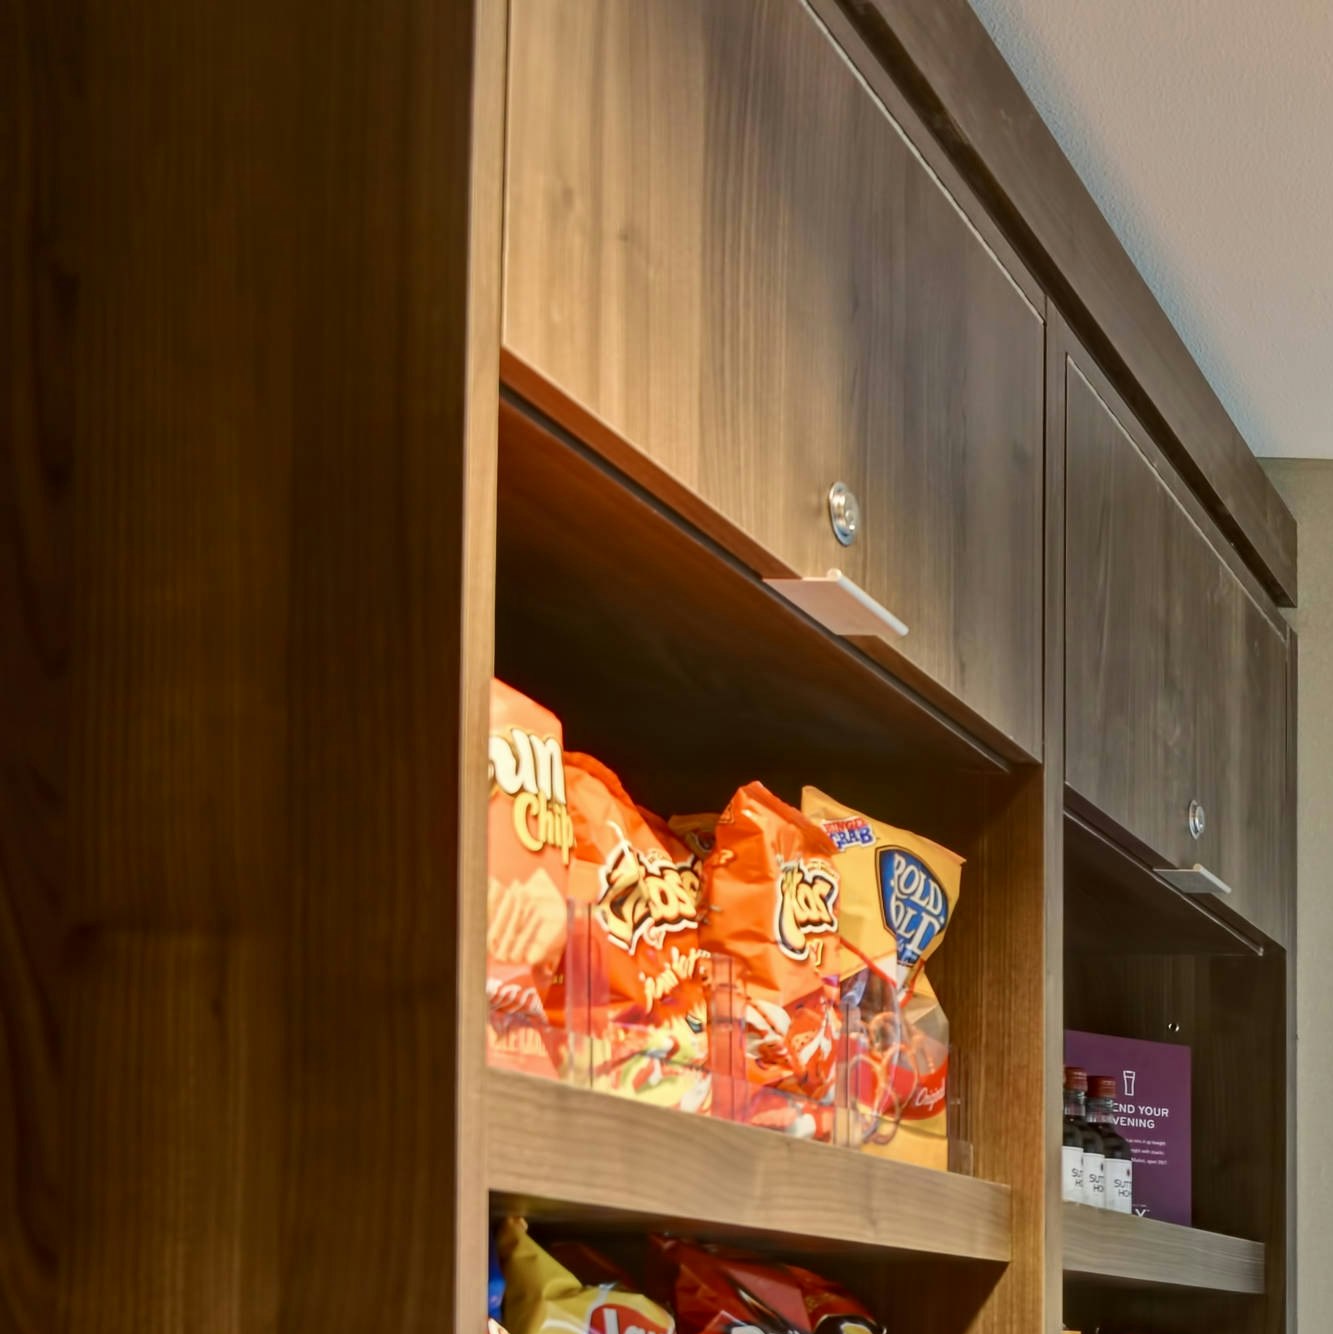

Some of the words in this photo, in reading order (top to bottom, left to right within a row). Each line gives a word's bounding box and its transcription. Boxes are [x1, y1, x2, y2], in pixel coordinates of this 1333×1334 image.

[489, 727, 567, 805] un
[514, 790, 577, 866] Chip
[1113, 1103, 1135, 1114] END
[1139, 1106, 1169, 1117] YOUR
[1113, 1117, 1155, 1129] VENING
